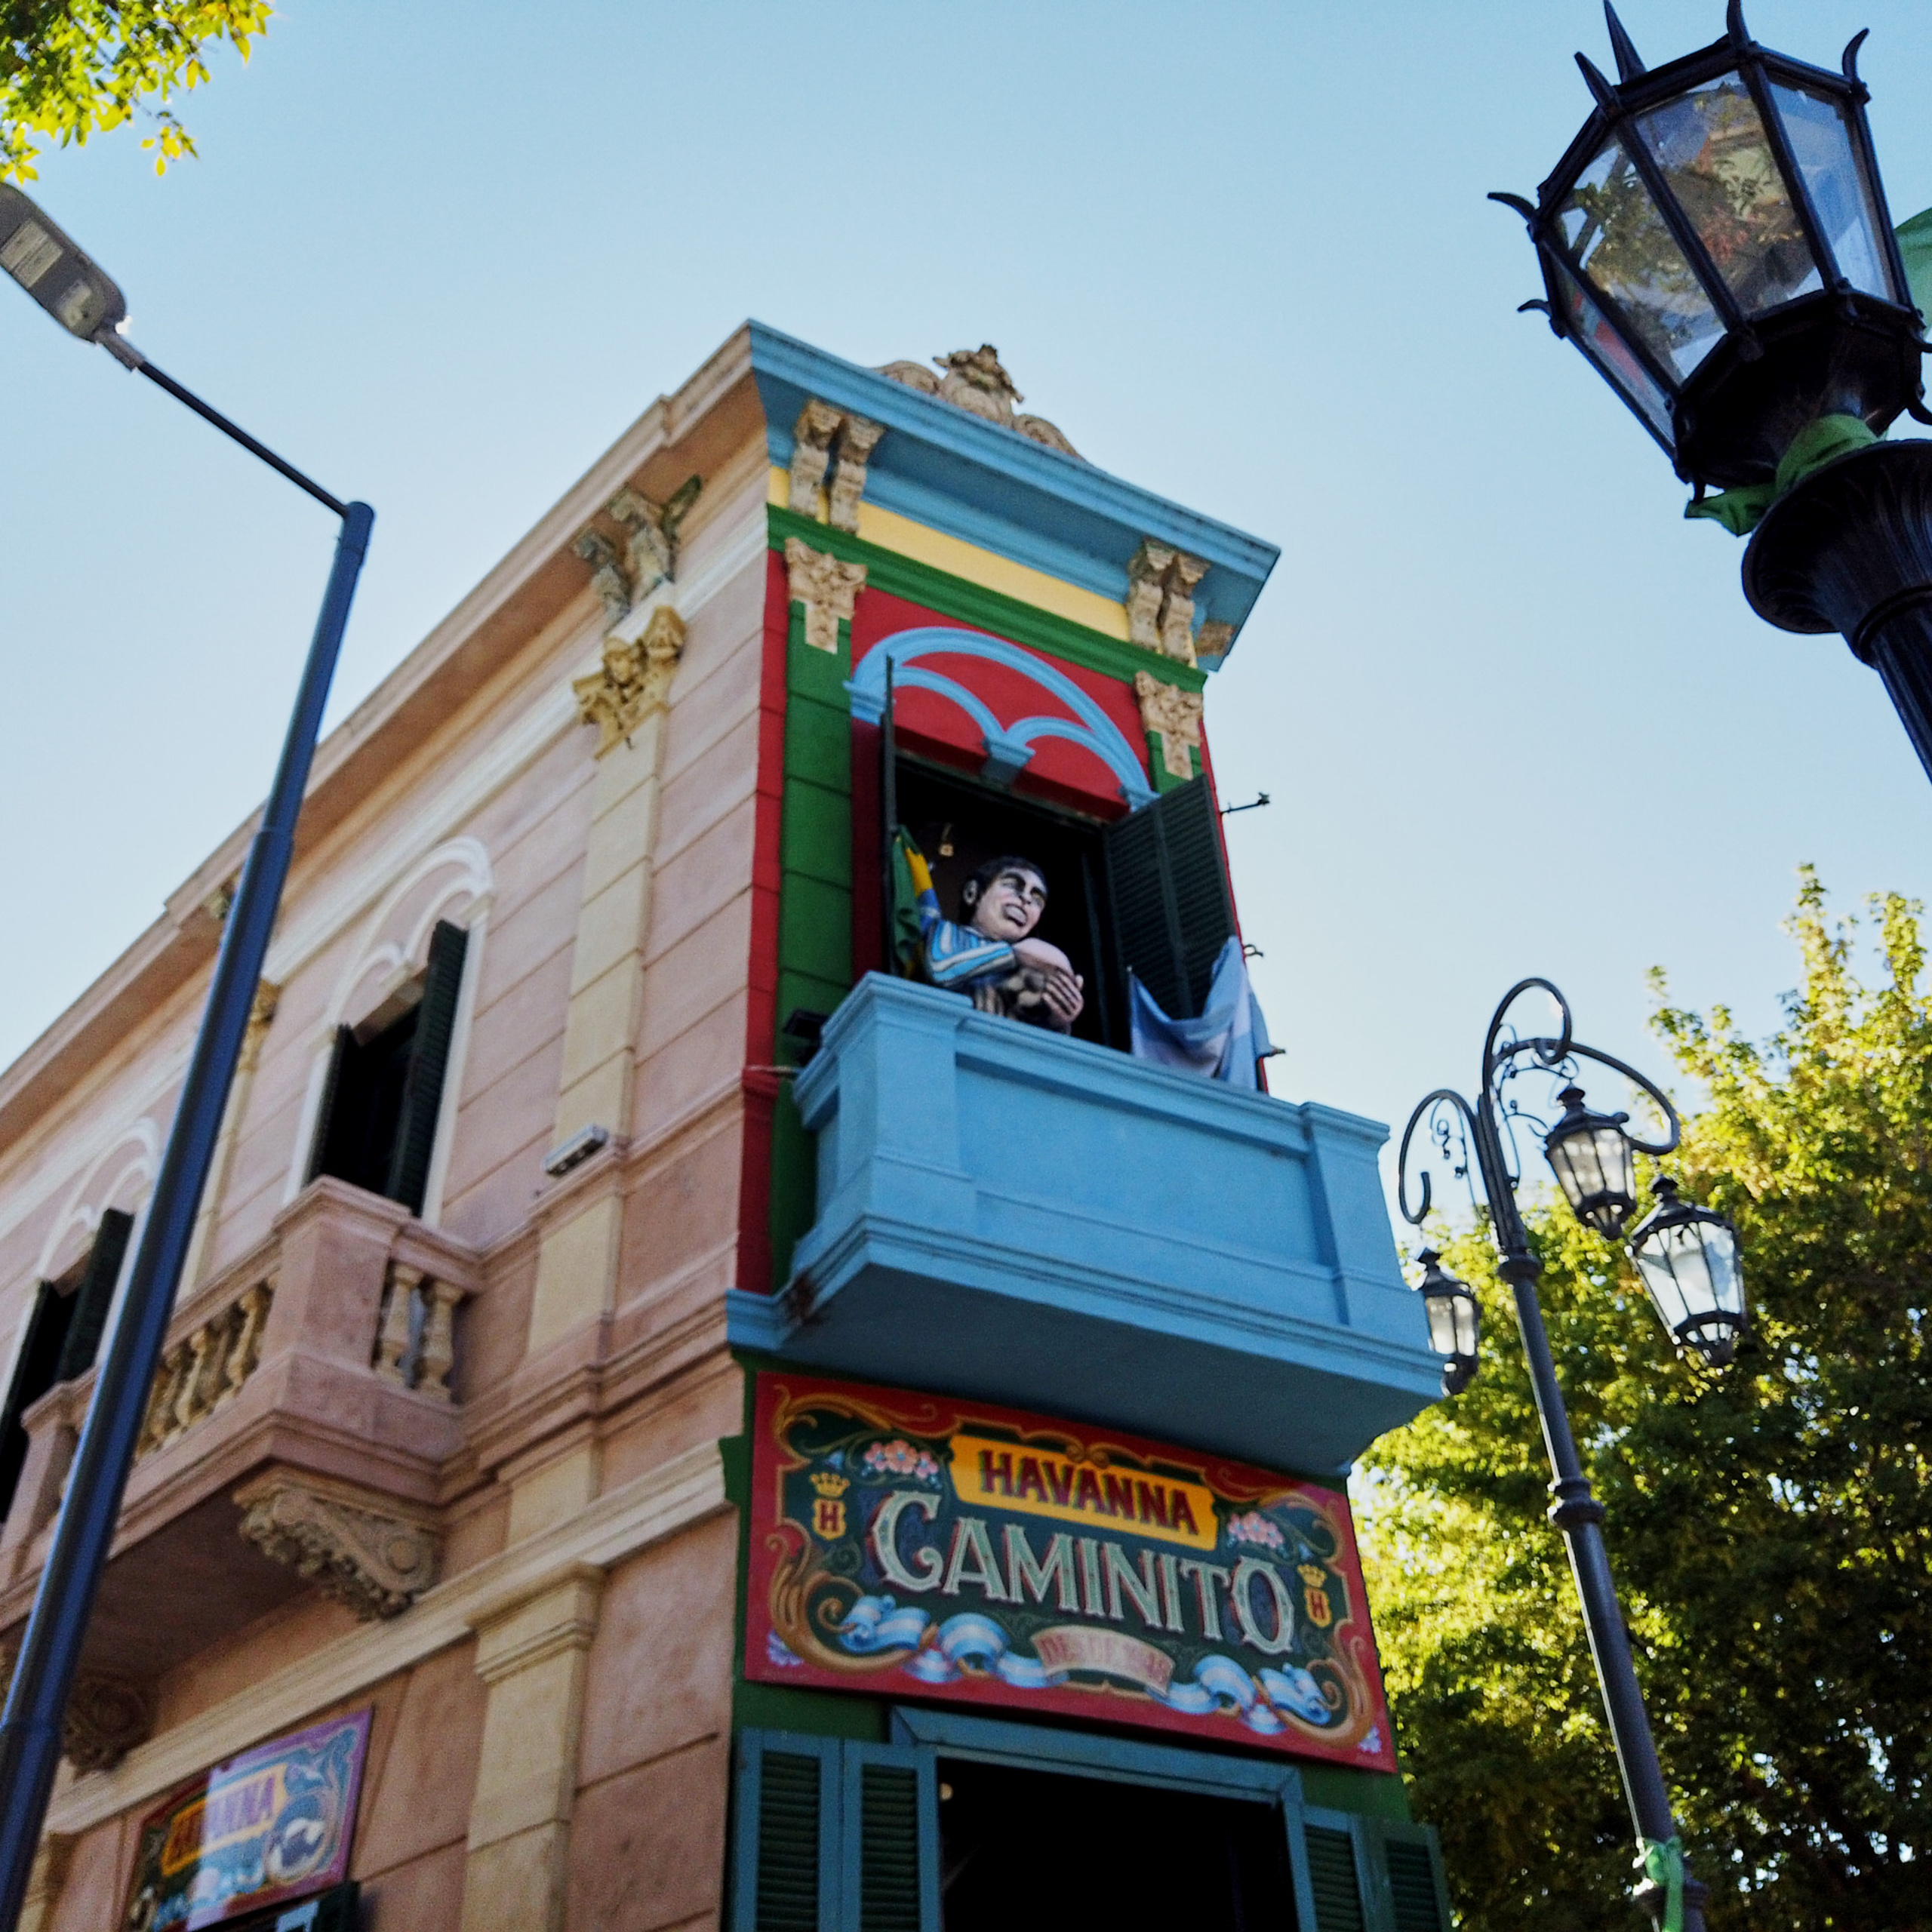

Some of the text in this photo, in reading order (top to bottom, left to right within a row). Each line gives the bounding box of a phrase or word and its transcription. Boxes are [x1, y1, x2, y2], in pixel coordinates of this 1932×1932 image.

[820, 1501, 839, 1532] H
[977, 1448, 1200, 1536] HAVANNA
[871, 1489, 1294, 1654] CAMINITO
[1310, 1591, 1325, 1620] H
